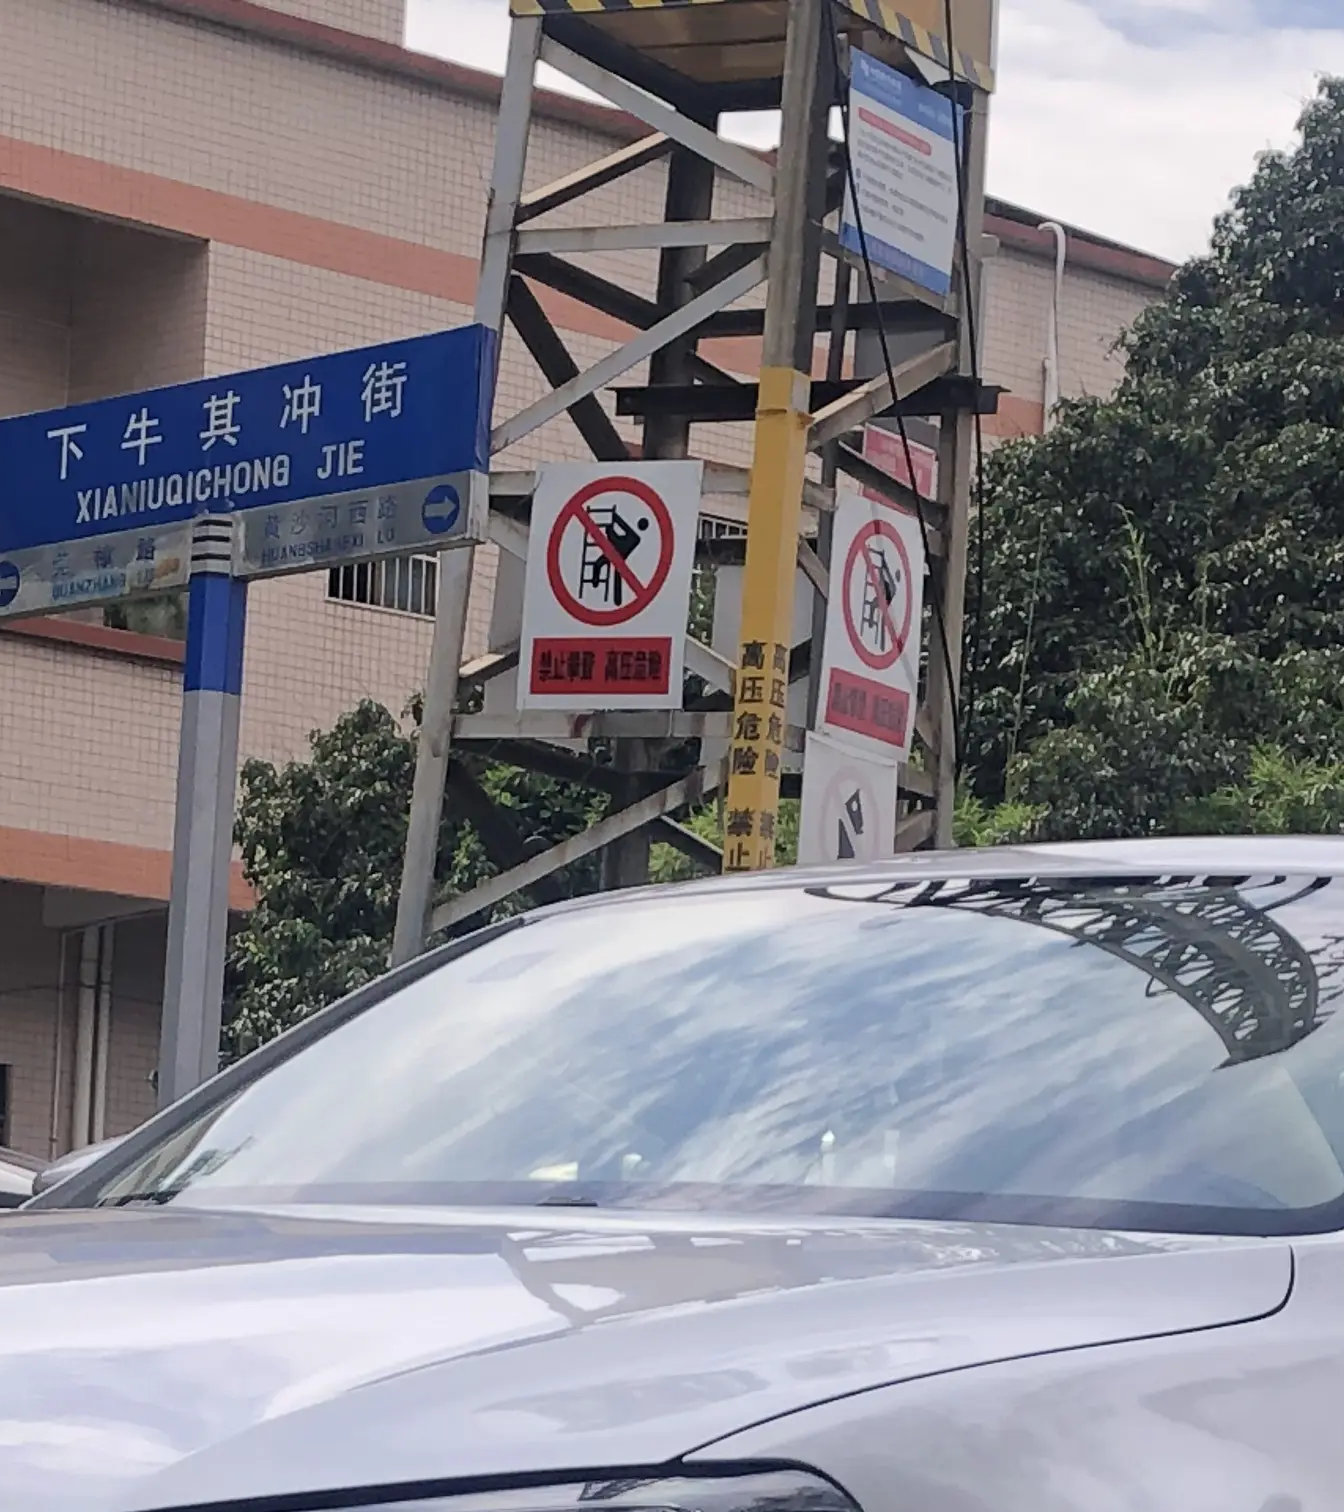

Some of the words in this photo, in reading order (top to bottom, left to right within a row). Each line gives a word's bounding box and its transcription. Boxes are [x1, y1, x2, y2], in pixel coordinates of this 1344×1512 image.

[47, 360, 408, 481] 下牛其冲街
[75, 454, 291, 525] XIANIUQICHONG
[316, 440, 366, 481] JIE
[731, 640, 768, 776] 高压危险
[724, 806, 755, 872] 禁止
